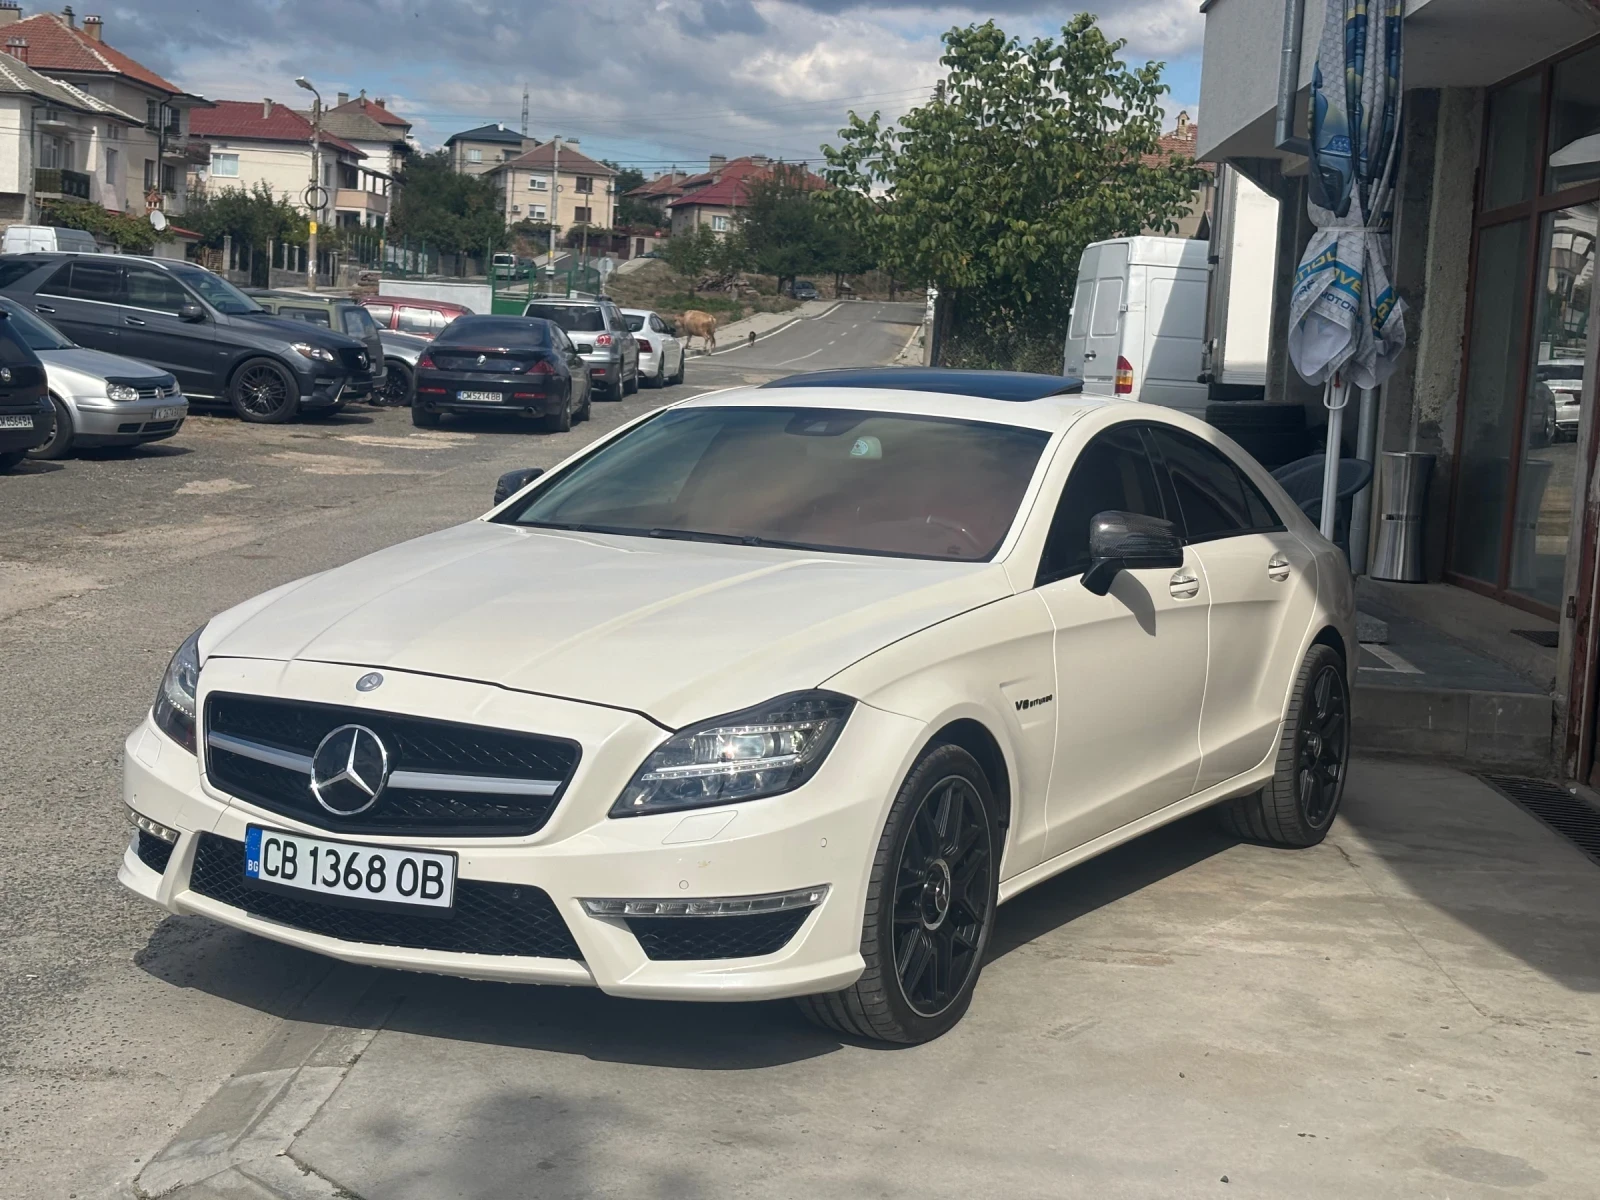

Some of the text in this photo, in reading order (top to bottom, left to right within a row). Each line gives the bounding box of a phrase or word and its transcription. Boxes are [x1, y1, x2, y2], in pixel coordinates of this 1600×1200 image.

[247, 859, 259, 872] BG
[263, 837, 298, 880] CB
[309, 846, 387, 893] 1368
